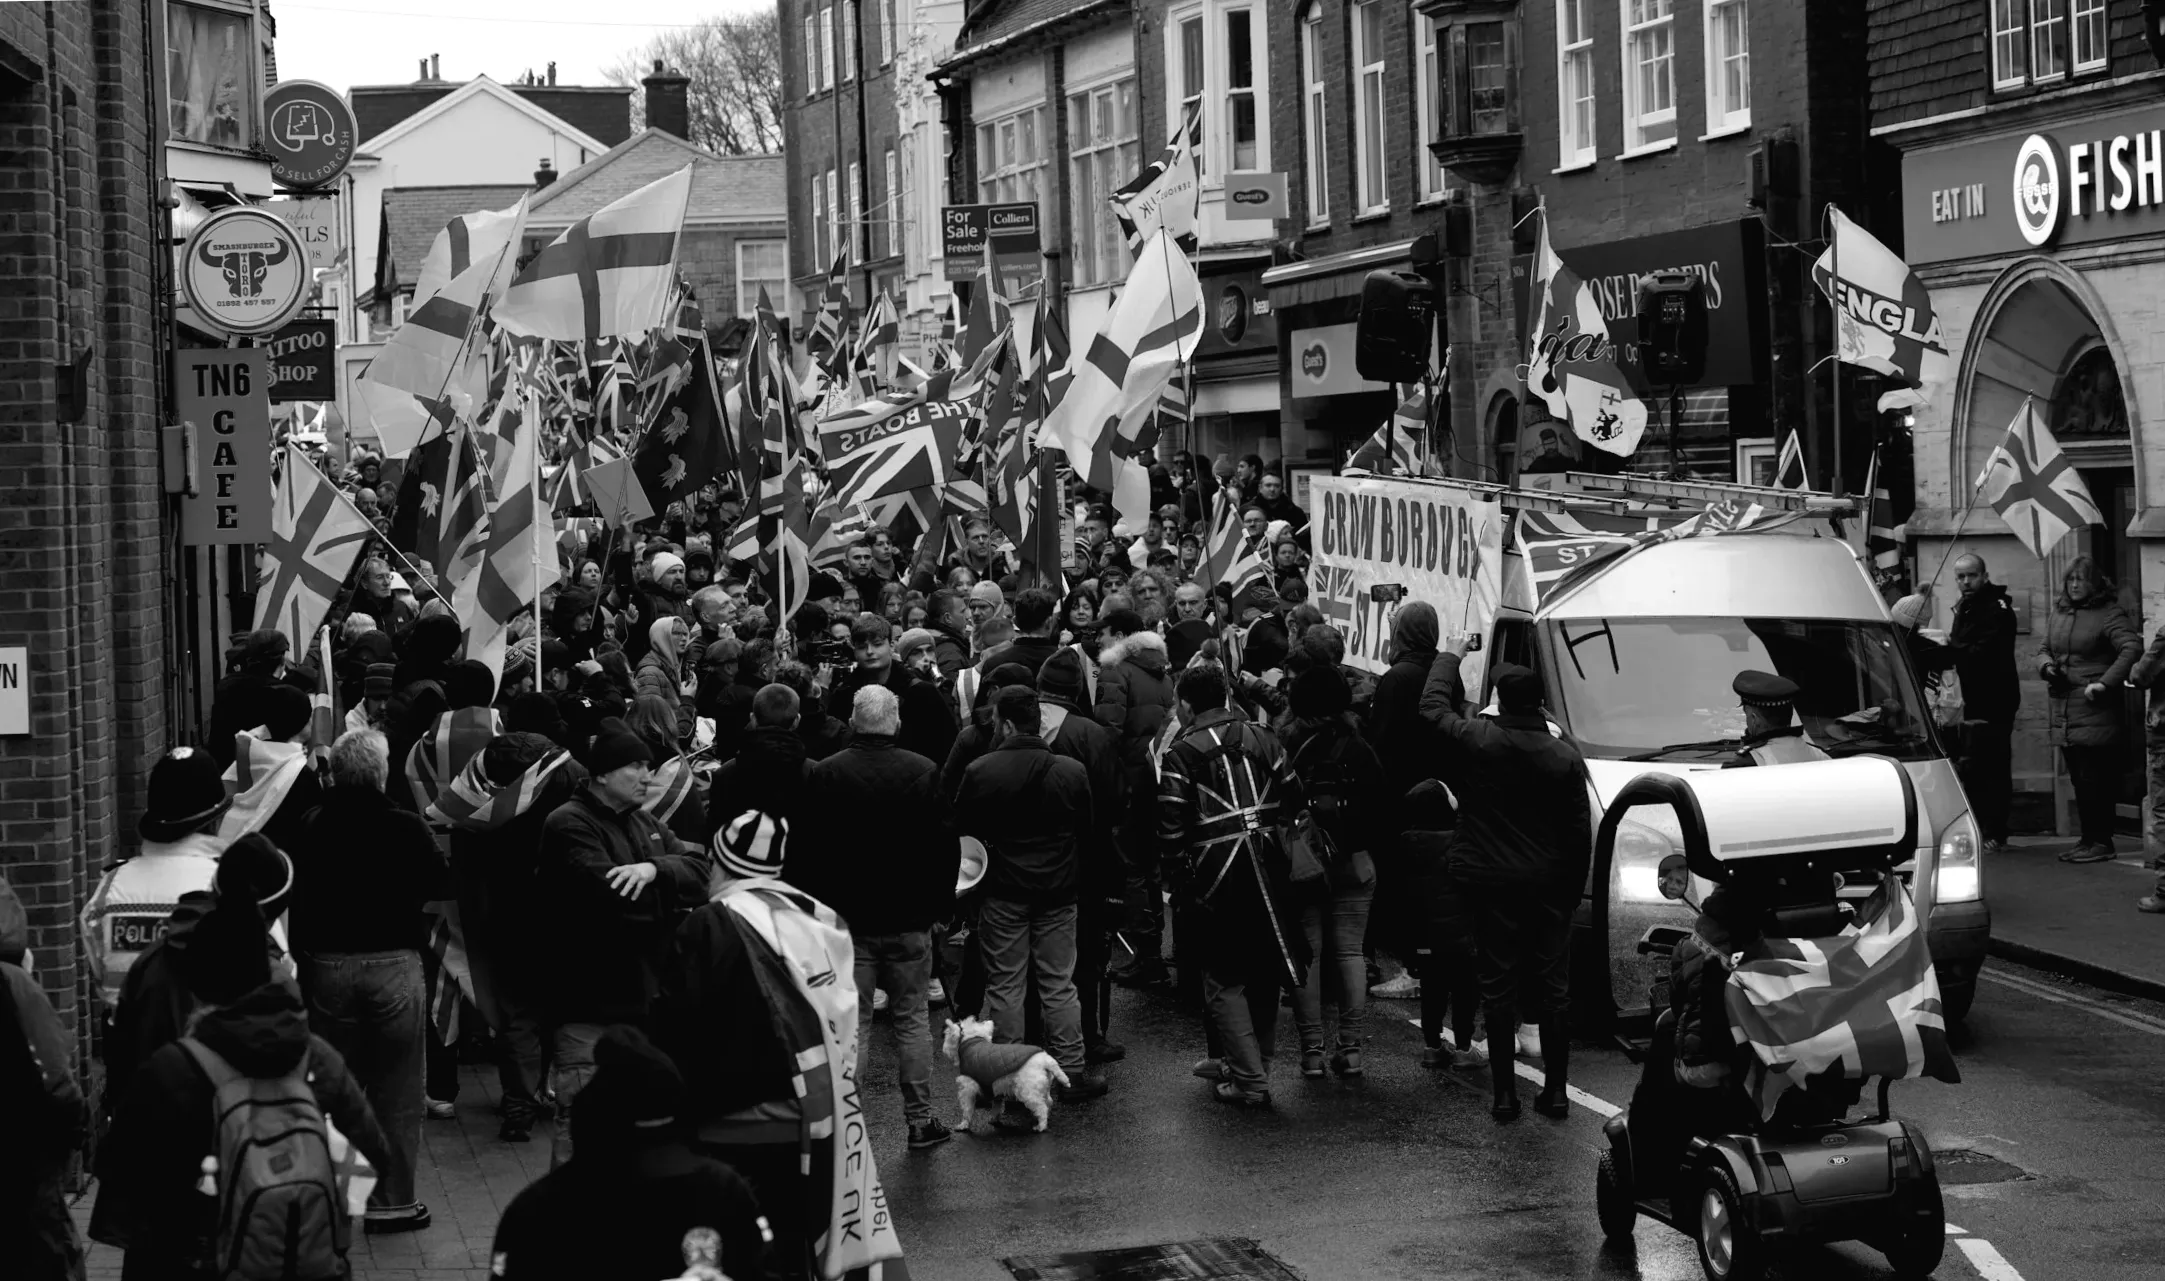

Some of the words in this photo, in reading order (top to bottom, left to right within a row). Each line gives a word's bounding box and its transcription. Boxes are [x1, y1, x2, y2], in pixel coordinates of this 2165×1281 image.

[287, 169, 314, 180] SELL
[317, 160, 339, 177] FOR
[335, 131, 350, 161] CASH
[1235, 192, 1265, 201] Guest's
[1932, 187, 1961, 222] EAT
[1965, 183, 1985, 217] IN
[946, 210, 971, 224] For
[993, 212, 1030, 224] Colliers
[946, 224, 978, 239] Sale
[212, 242, 275, 251] SMASHBURGER
[947, 242, 985, 253] Freehol
[240, 253, 250, 297] TORO
[1304, 353, 1324, 369] Guest's
[192, 363, 250, 397] TN6
[212, 410, 239, 529] CAFE
[1557, 545, 1597, 565] ST
[114, 925, 169, 943] POLIC
